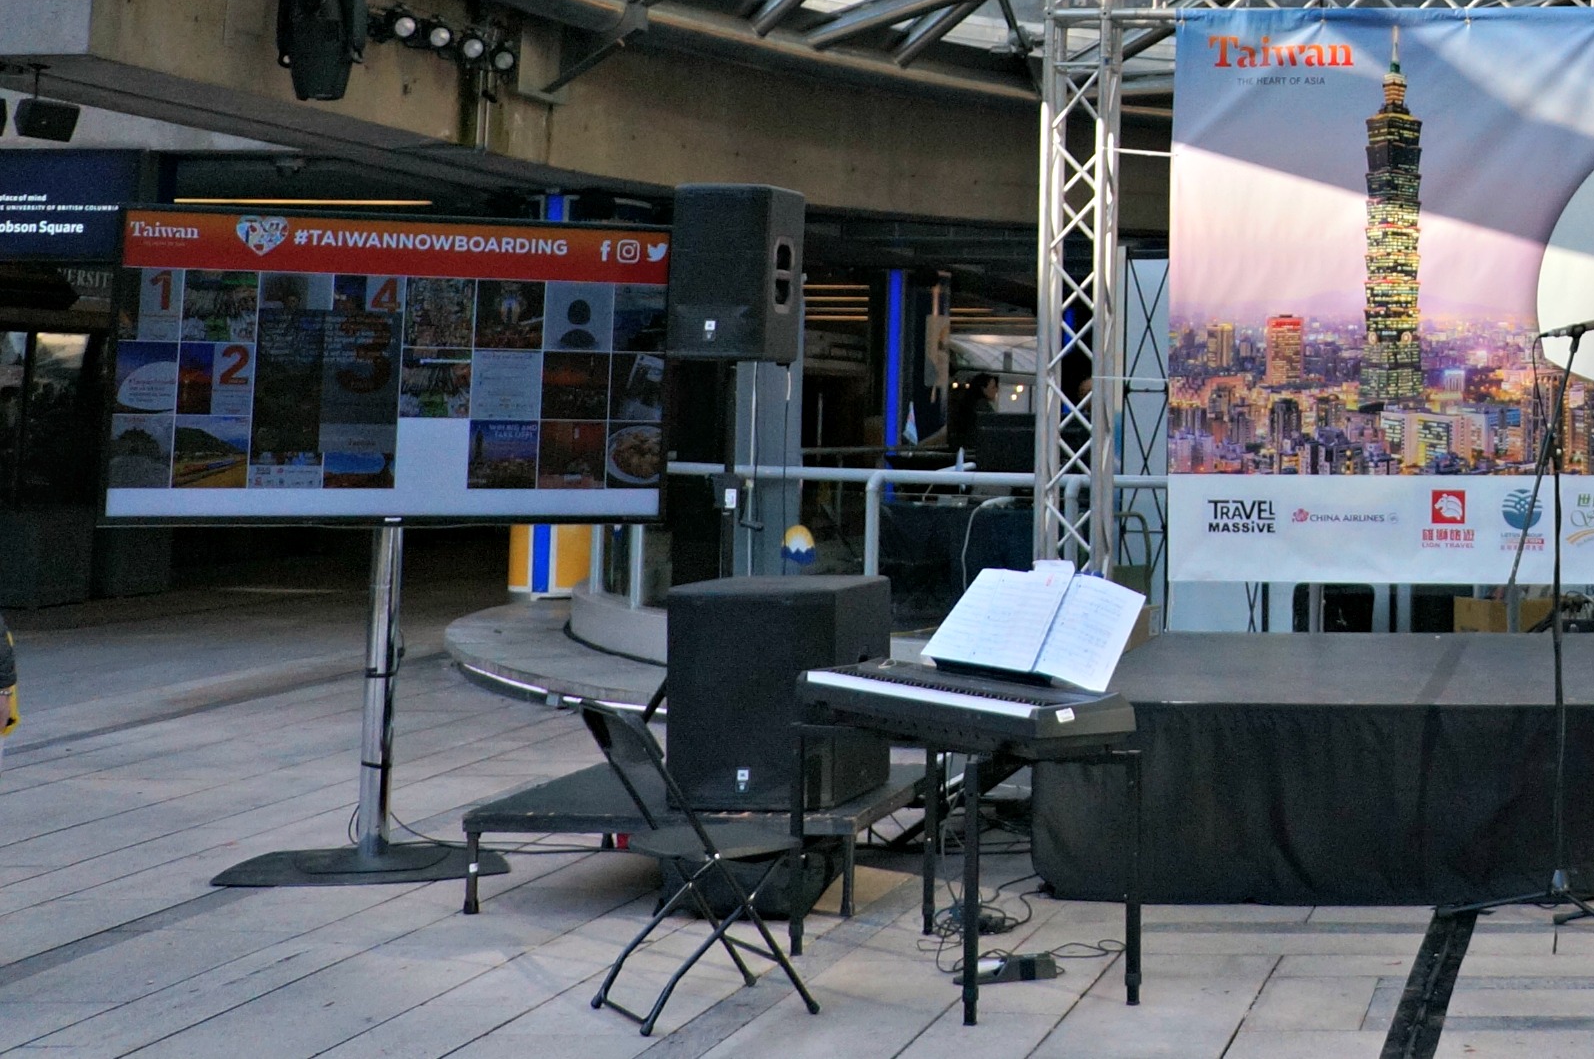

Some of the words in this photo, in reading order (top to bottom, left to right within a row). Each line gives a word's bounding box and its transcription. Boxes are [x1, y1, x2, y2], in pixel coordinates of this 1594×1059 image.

[1207, 35, 1355, 68] Taiwan
[1256, 77, 1287, 86] HEART
[1304, 77, 1326, 86] ASIA
[39, 220, 84, 236] Square
[130, 221, 199, 239] Taiwan
[294, 229, 568, 256] #TAIWANNOWBOARDING
[219, 345, 250, 385] 2
[1208, 500, 1276, 521] TRAVEL
[1309, 514, 1341, 523] CHINA
[1342, 514, 1385, 523] AIRLINES
